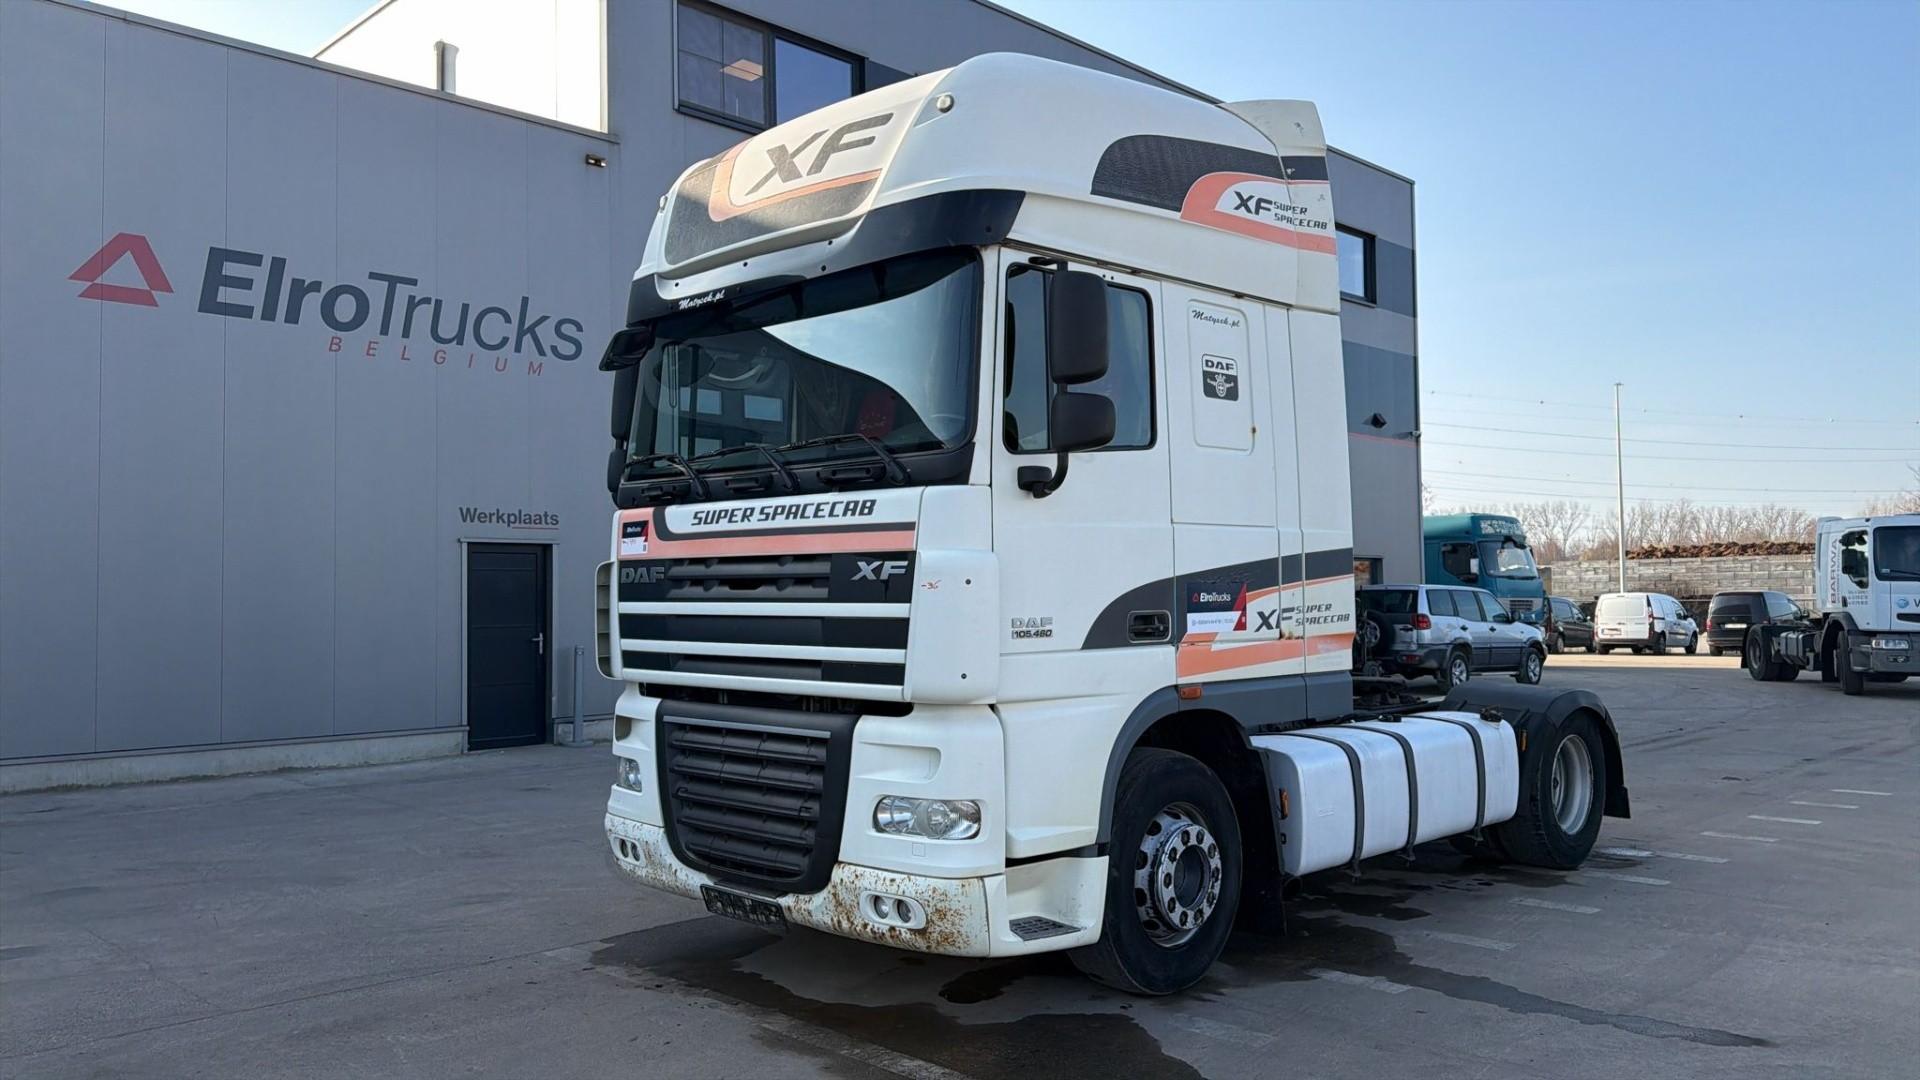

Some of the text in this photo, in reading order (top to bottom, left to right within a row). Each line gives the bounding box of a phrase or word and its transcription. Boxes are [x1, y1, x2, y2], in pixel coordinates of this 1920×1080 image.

[744, 112, 894, 196] XF
[1233, 190, 1273, 216] XF
[1273, 201, 1308, 216] SUPER
[1274, 212, 1328, 230] SPACECAB
[197, 246, 584, 361] ElroTrucks
[328, 336, 544, 377] BELGIUM
[1205, 359, 1234, 371] DAF
[459, 506, 559, 528] Werkplaats
[691, 499, 877, 526] SUPER SPACECAB
[620, 566, 665, 584] DAF
[850, 560, 909, 581] XF
[1830, 538, 1839, 604] BARWA
[1200, 592, 1231, 602] ElroTrucks
[1254, 606, 1296, 632] XF
[1295, 603, 1333, 615] SUPER
[1011, 616, 1053, 628] DAF
[1295, 613, 1351, 627] SPACECAB
